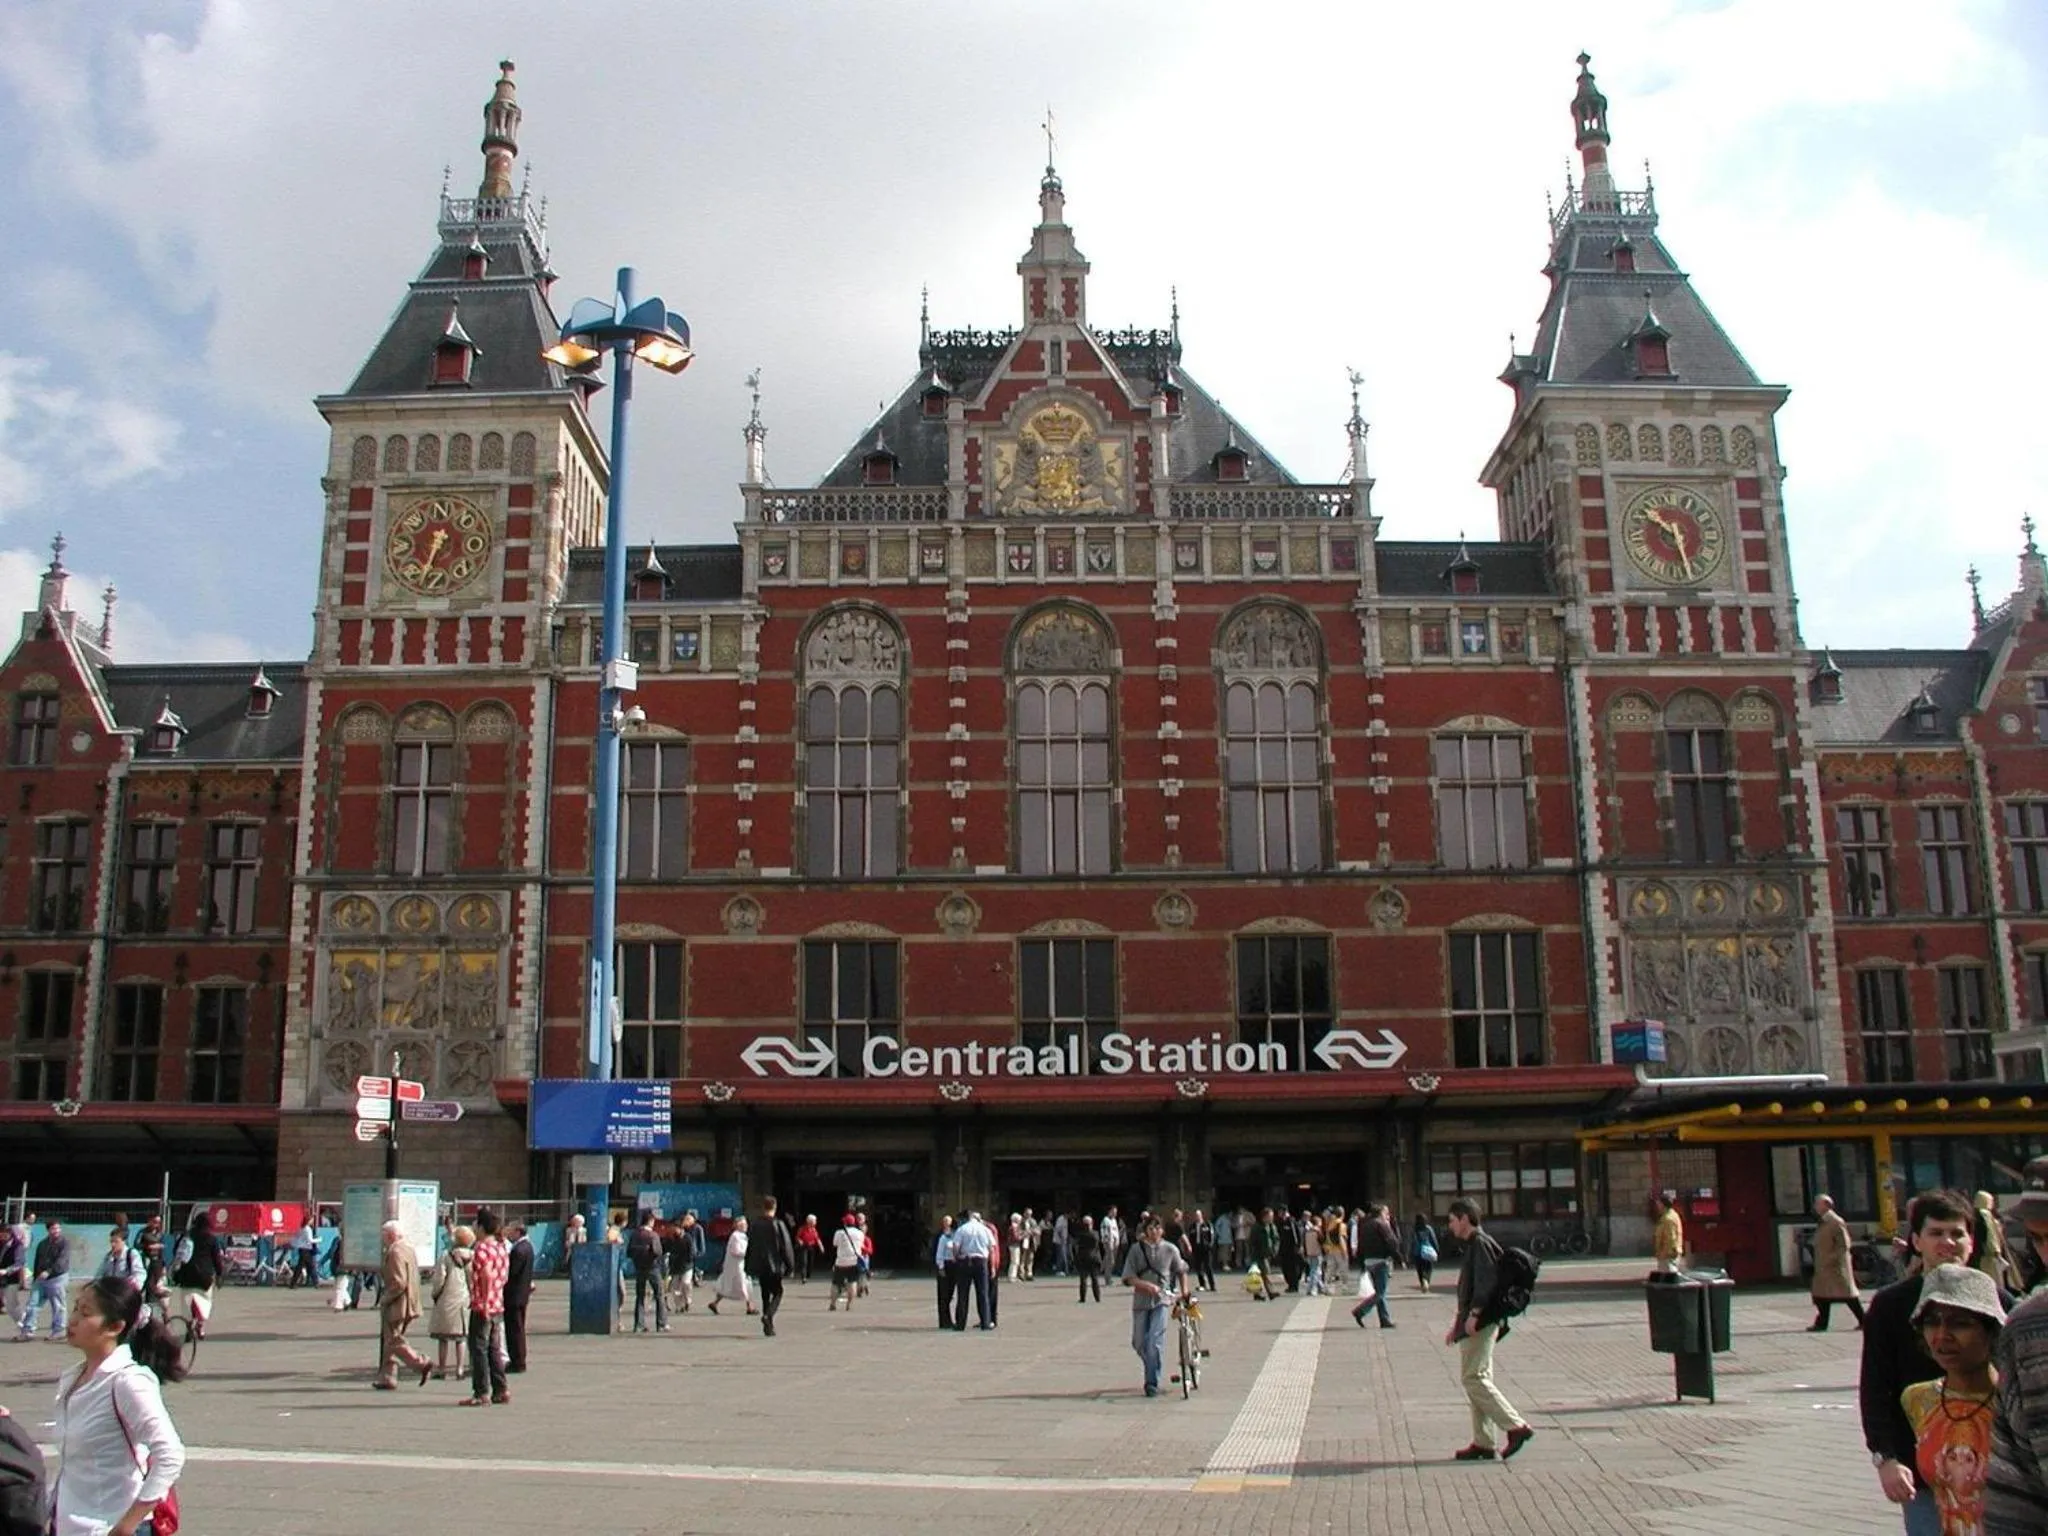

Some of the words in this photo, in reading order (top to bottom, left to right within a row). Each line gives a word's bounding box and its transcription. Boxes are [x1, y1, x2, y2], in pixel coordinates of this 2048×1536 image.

[433, 502, 450, 518] N
[467, 536, 483, 553] O
[863, 1034, 1079, 1076] Centraal
[1100, 1032, 1287, 1074] Station
